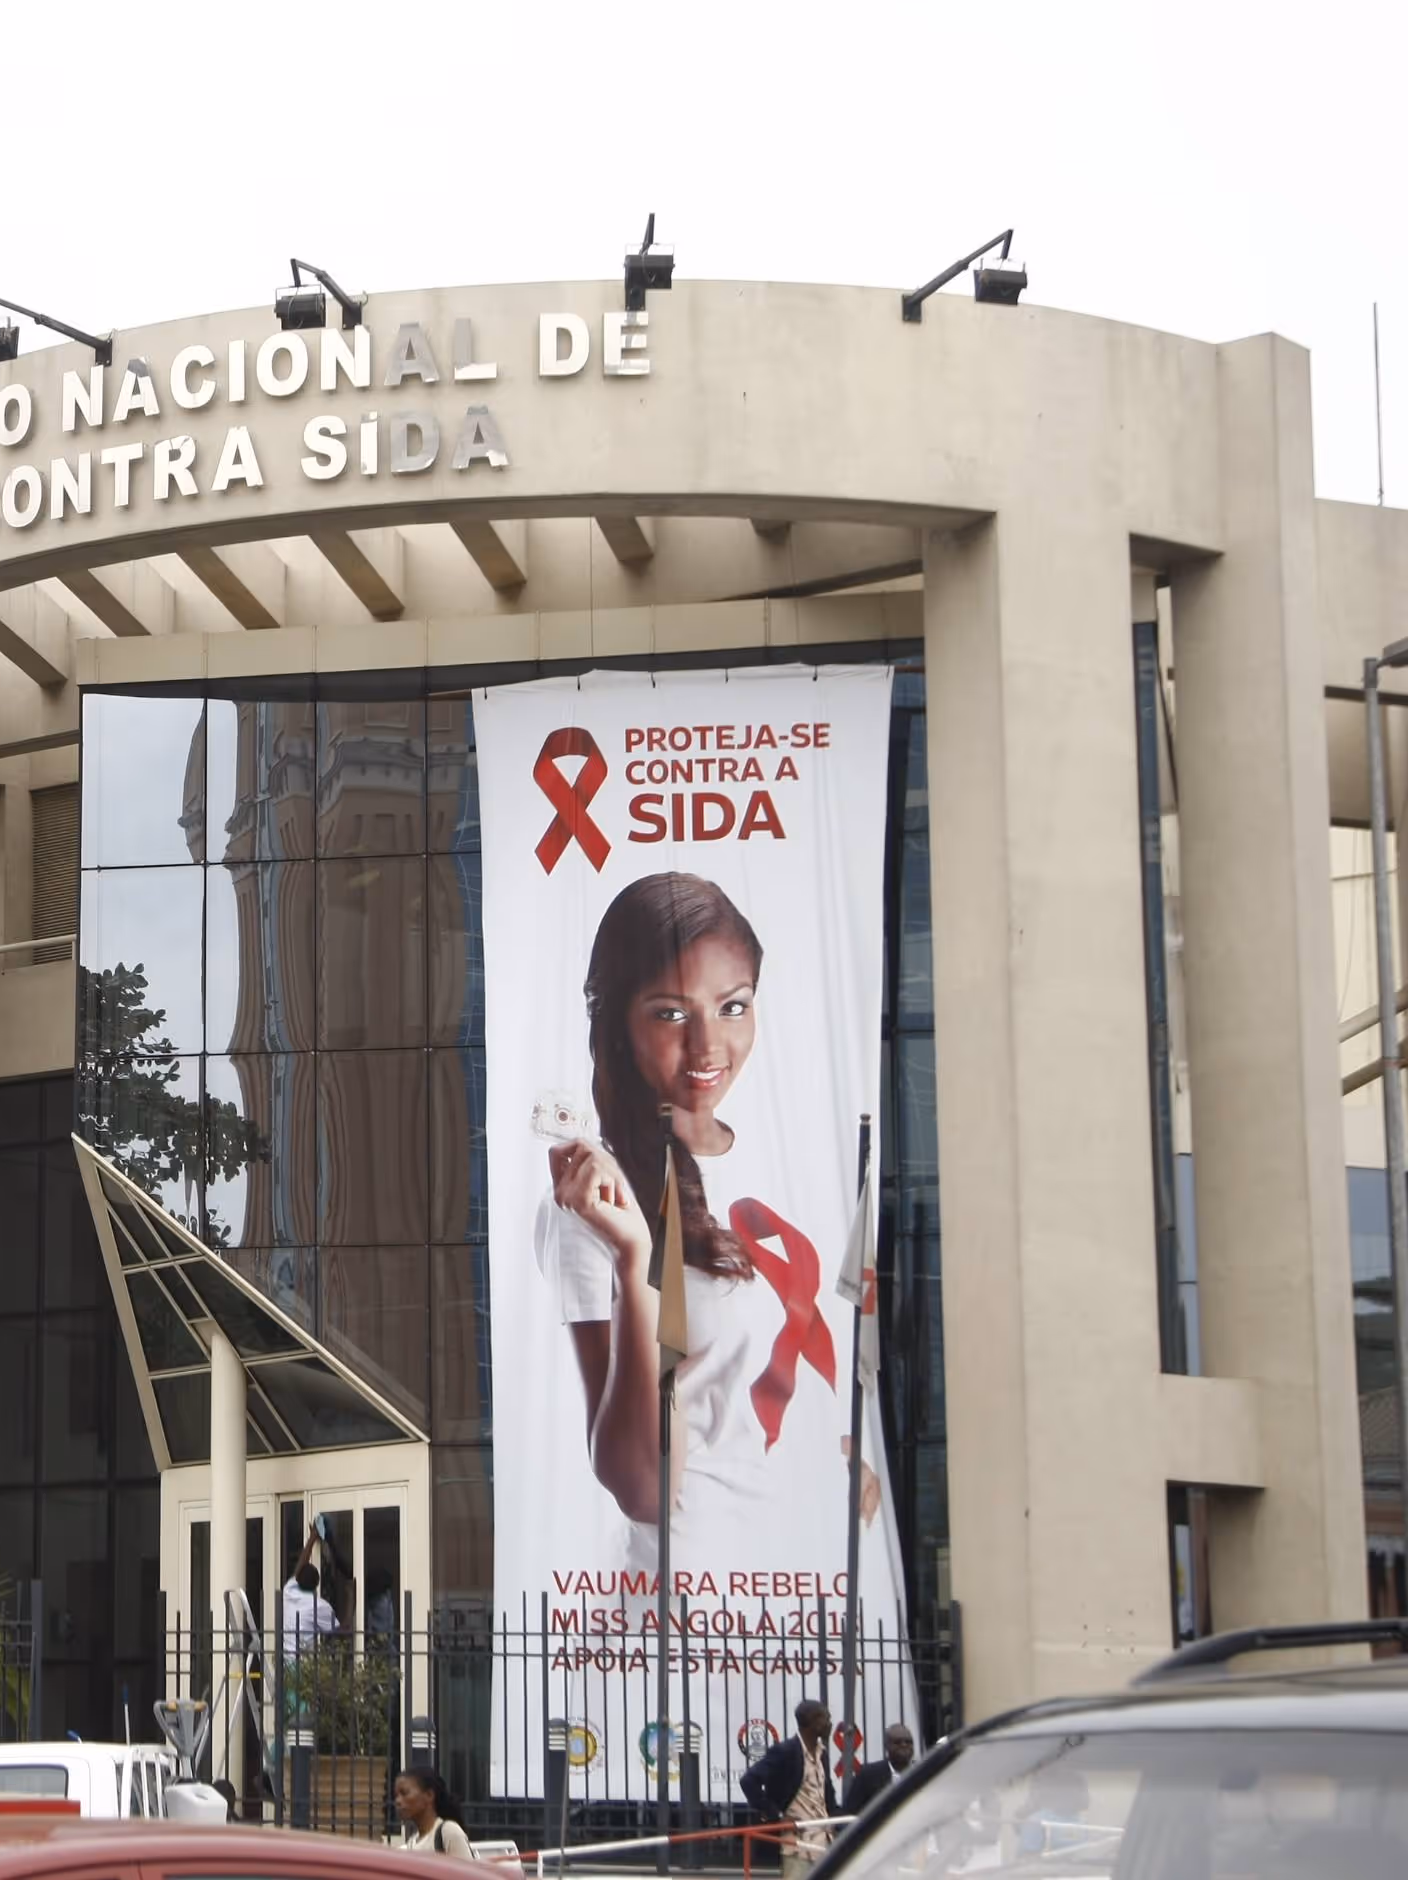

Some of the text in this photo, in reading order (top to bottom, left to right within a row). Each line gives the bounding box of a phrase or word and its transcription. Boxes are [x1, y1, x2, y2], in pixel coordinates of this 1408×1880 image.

[62, 318, 497, 432] NACIONAL
[539, 312, 650, 376] DE
[301, 405, 509, 480] SIDA
[625, 723, 831, 754] PROTEJA-SE
[625, 756, 799, 786] CONTRA A
[627, 790, 787, 844] SIDA
[552, 1608, 629, 1635] MSS
[788, 1610, 860, 1638] 201
[749, 1650, 864, 1675] CAUS
